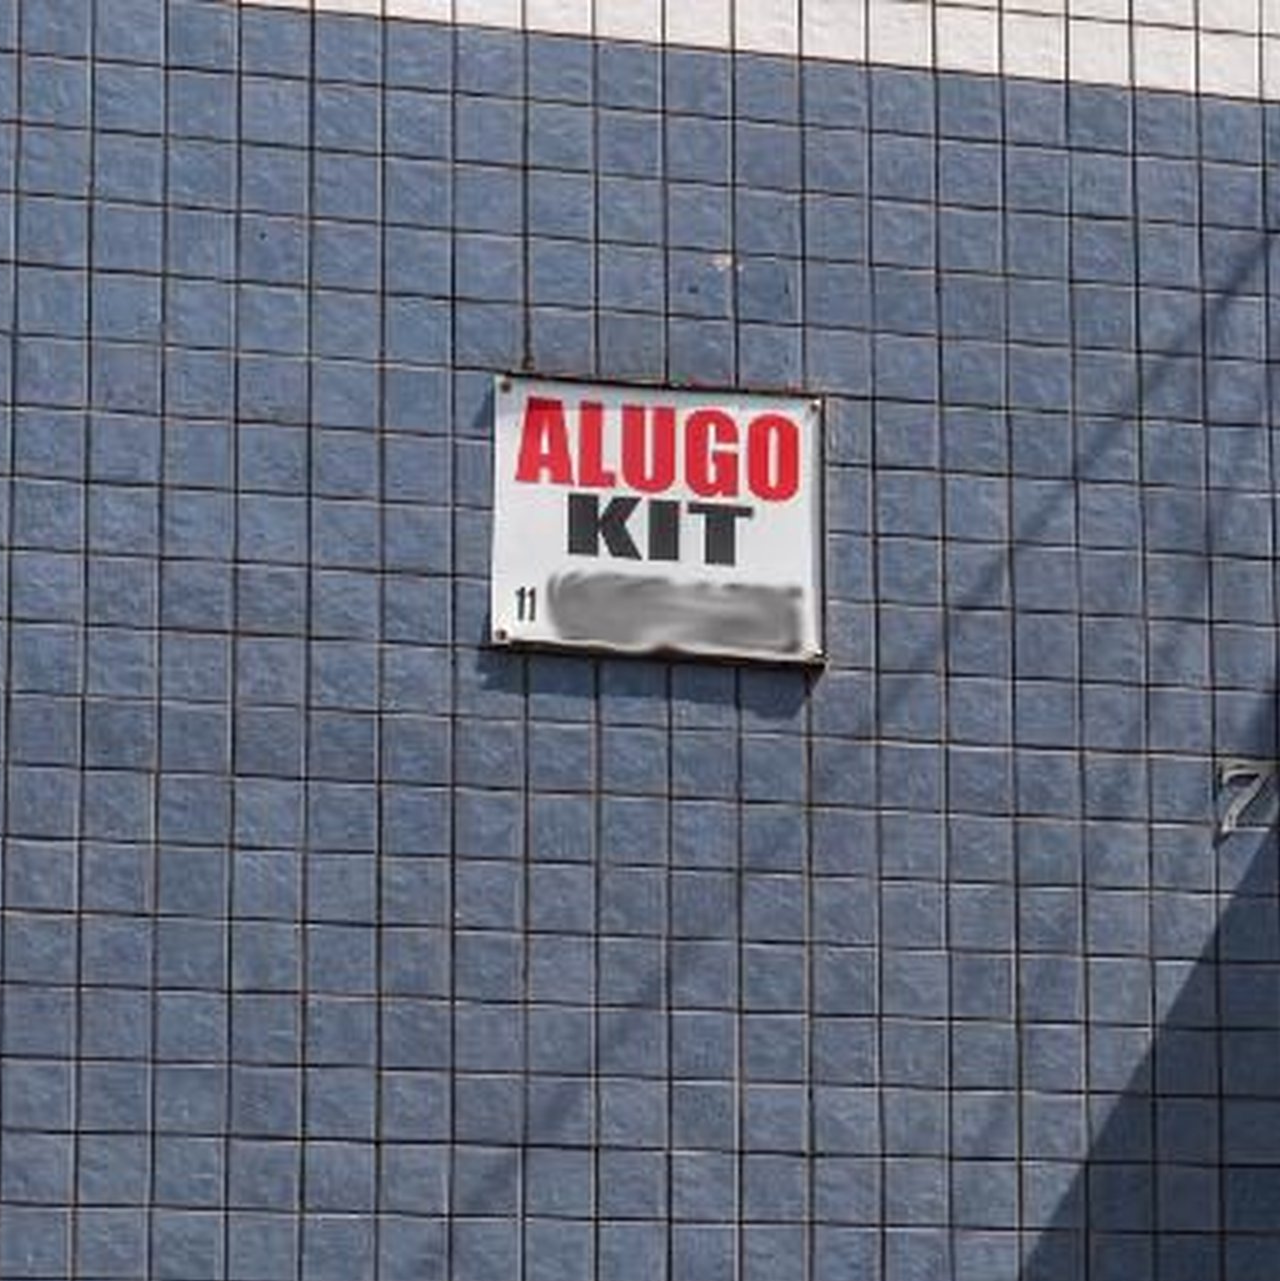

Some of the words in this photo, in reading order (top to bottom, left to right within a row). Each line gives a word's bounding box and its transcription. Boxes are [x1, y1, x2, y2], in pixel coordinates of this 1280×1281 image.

[515, 396, 800, 502] ALUGO
[567, 493, 754, 567] KIT
[515, 586, 537, 622] 11
